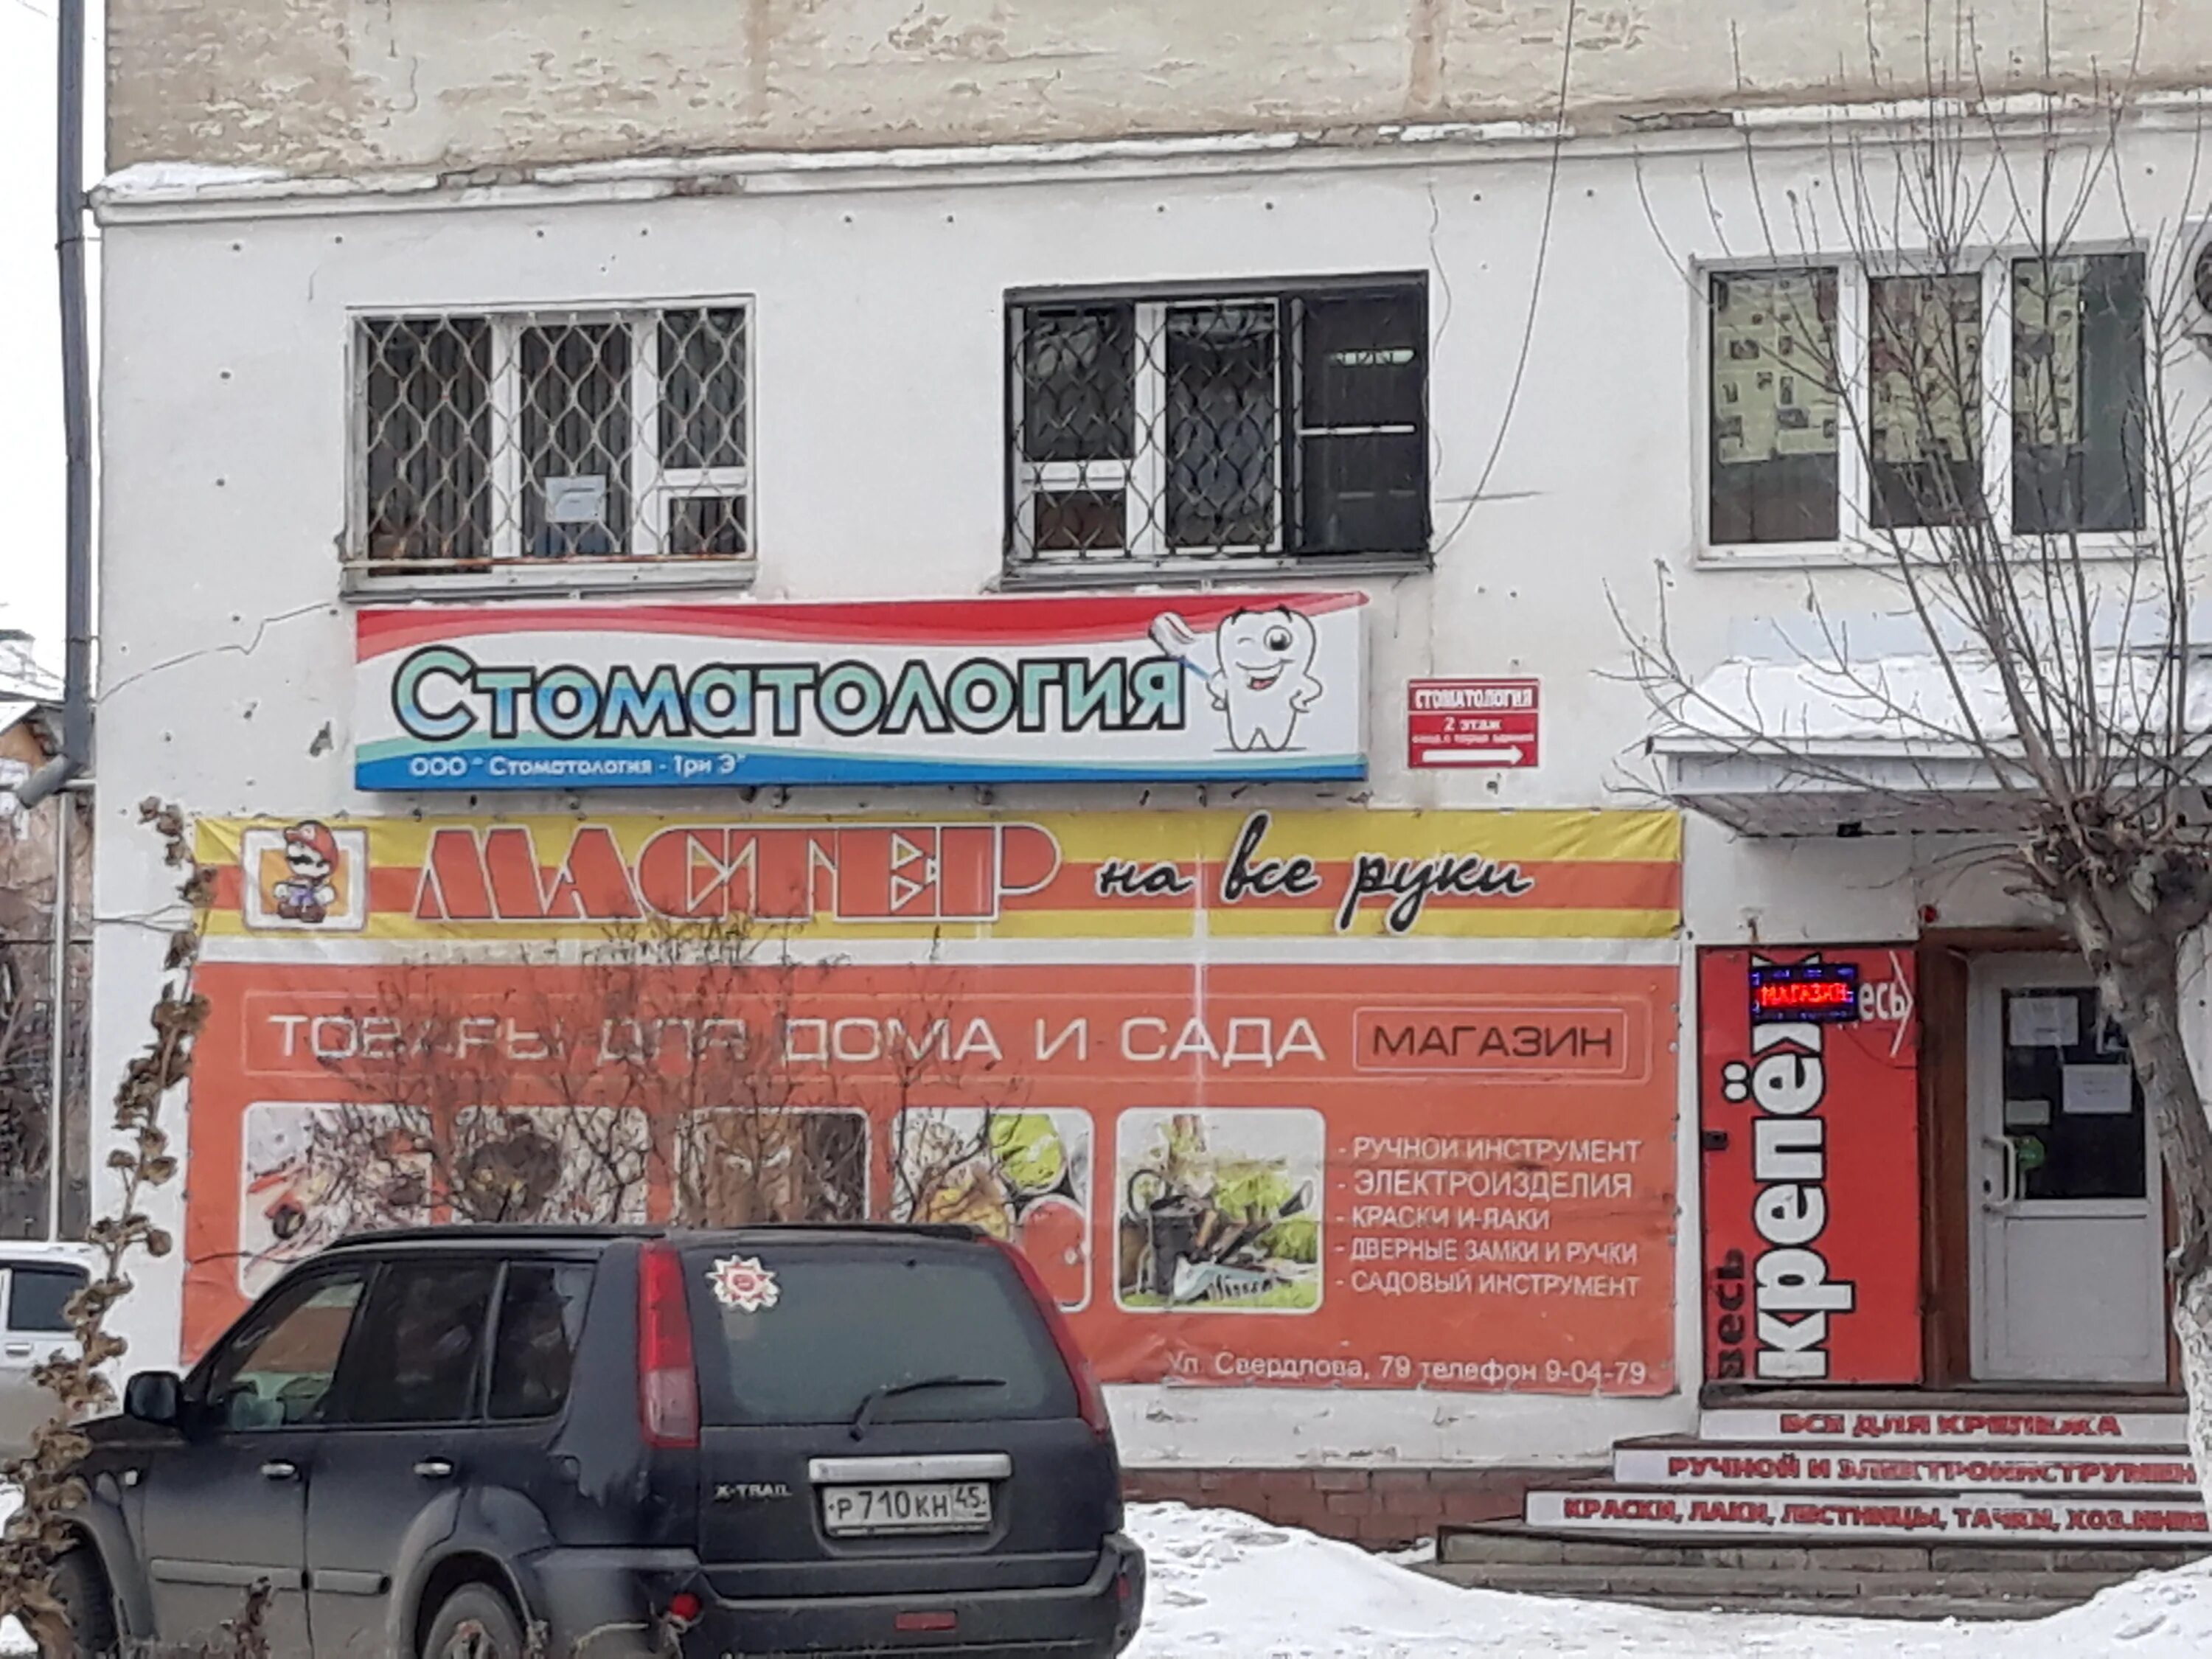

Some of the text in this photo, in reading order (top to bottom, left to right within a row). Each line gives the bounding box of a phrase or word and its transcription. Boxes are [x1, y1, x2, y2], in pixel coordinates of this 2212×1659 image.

[392, 644, 1185, 740] Стоматология
[1443, 716, 1456, 731] 2
[409, 756, 467, 776] ООО
[1096, 858, 1194, 899] на
[1220, 810, 1320, 903] все
[1334, 850, 1536, 935] руки
[782, 1017, 1004, 1069] ДОМА
[1036, 1018, 1088, 1062] И
[1120, 1016, 1327, 1069] САДА
[1371, 1026, 1613, 1058] МАГАЗИН
[1466, 1138, 1643, 1163] ИНСТРУМЕНТ
[1353, 1169, 1633, 1202] ЭЛЕКТРОИЗДЕЛИЯ
[1352, 1205, 1449, 1228] КРАСКИ
[1349, 1237, 1638, 1265] ДВЕРНЫЕ ЗАМКИ И РУЧКИ
[1351, 1270, 1641, 1298] САДОВЫЙ ИНСТРУМЕНТ
[1379, 1355, 1411, 1379] 79
[1422, 1358, 1537, 1384] телефон
[1545, 1360, 1646, 1385] 9-04-79
[1852, 1414, 1930, 1437] ДЛЯ
[1808, 1458, 1831, 1479] И
[1837, 1458, 2197, 1484] ЭЛЕКТРОИНСТРУМЕН
[714, 1484, 793, 1501] X-TRAIL
